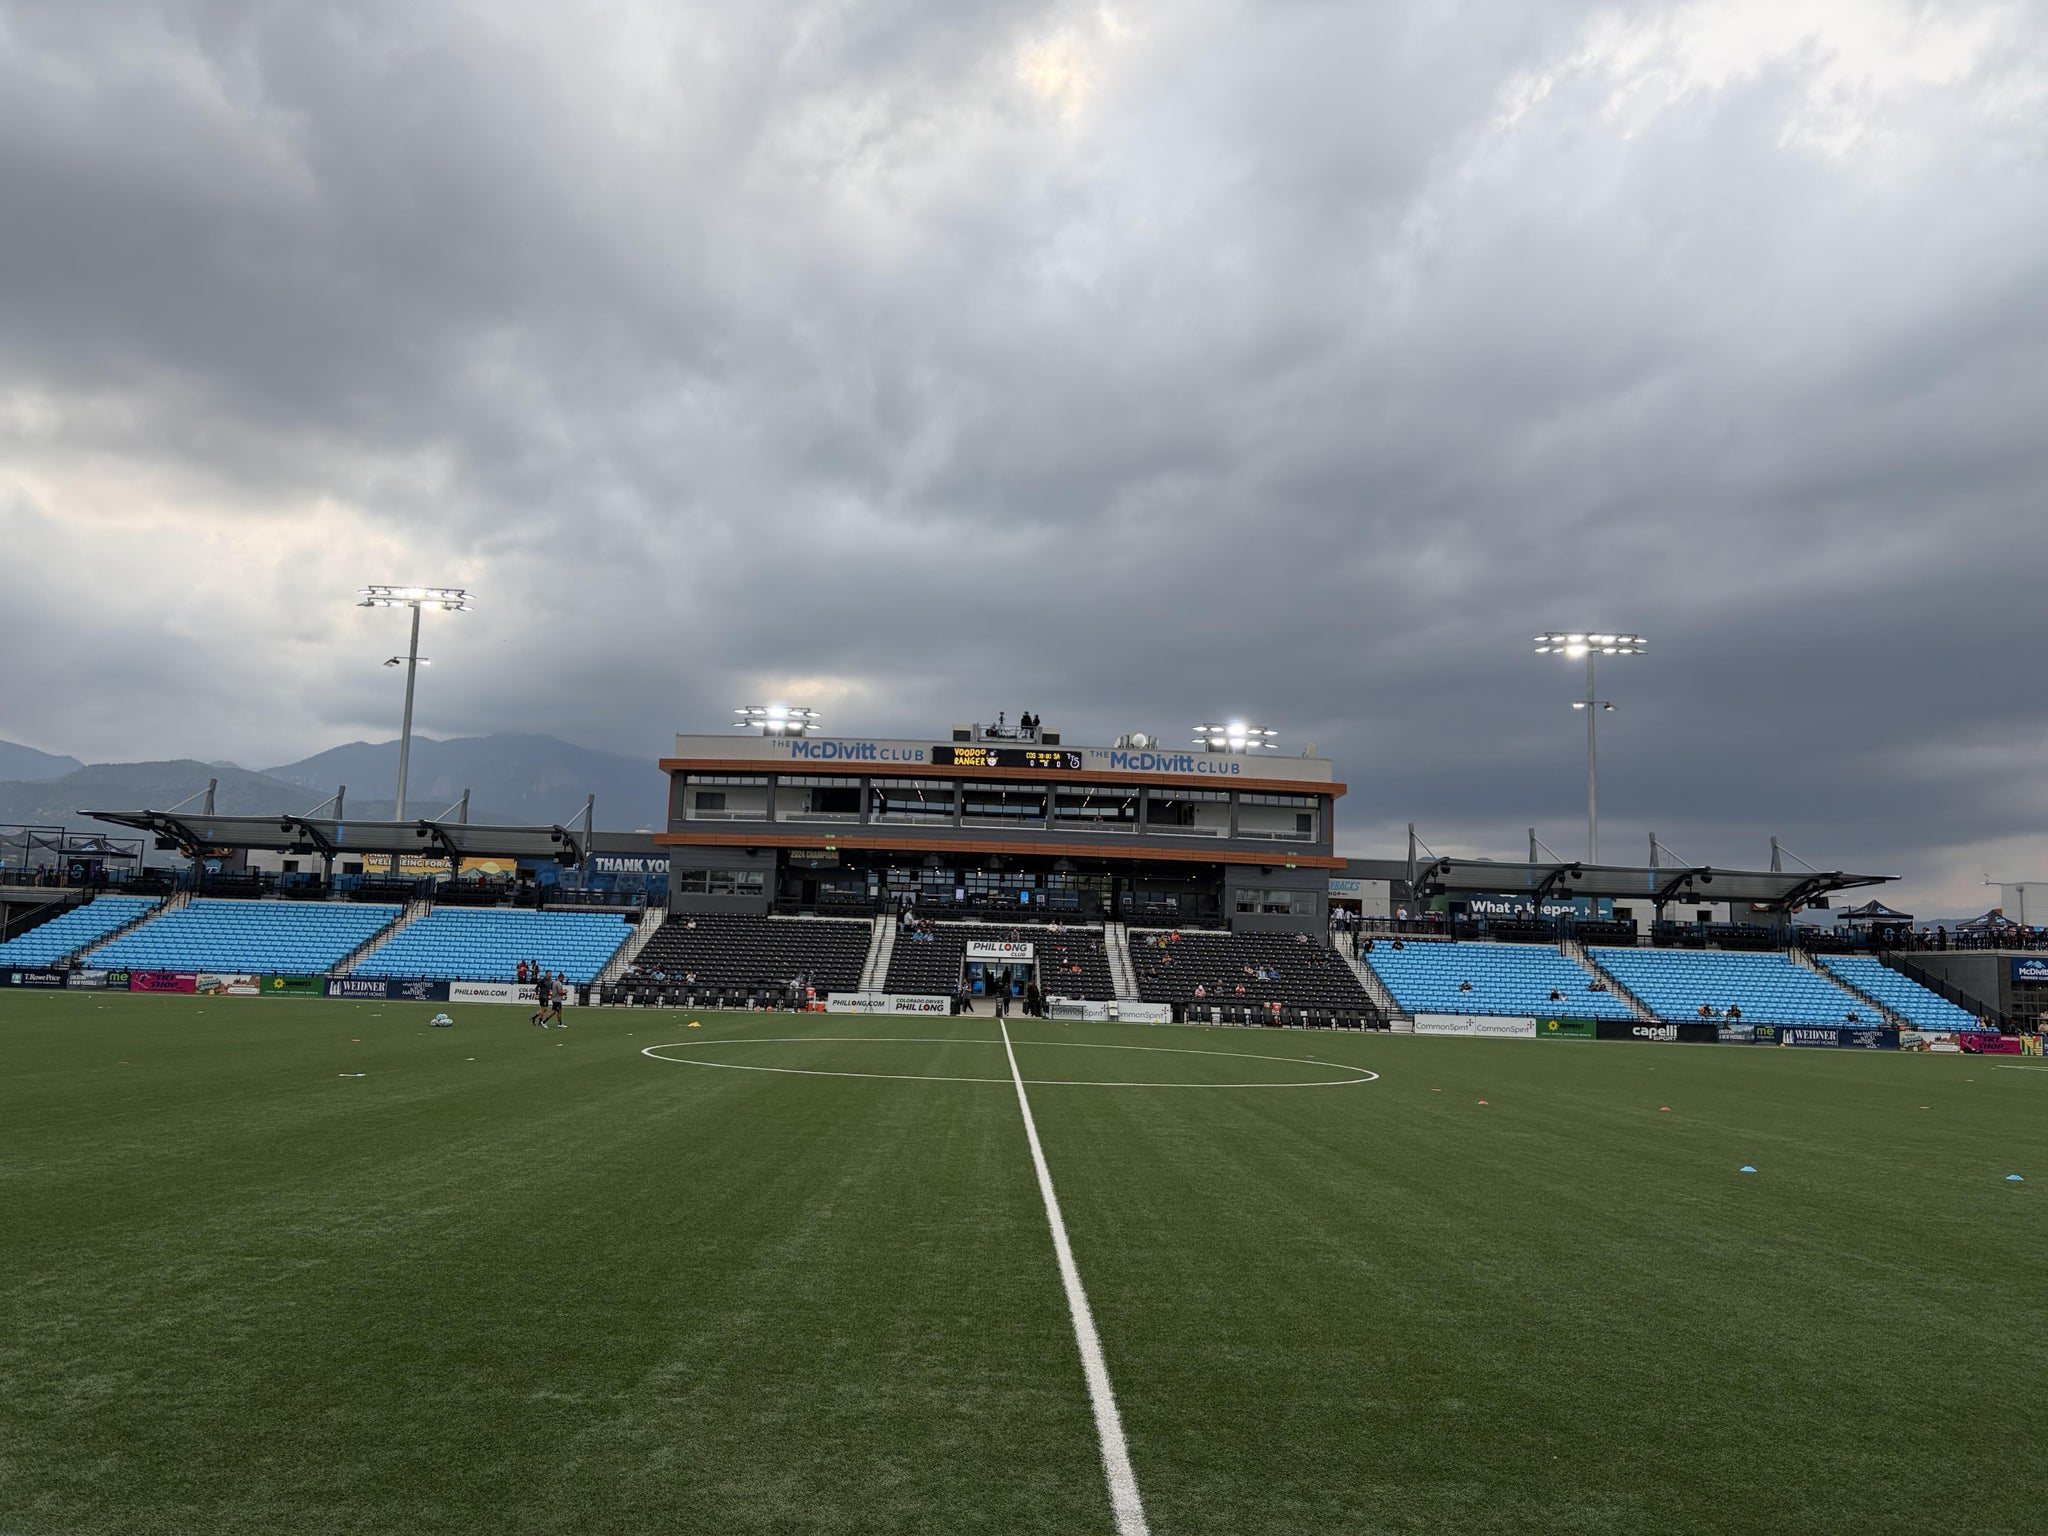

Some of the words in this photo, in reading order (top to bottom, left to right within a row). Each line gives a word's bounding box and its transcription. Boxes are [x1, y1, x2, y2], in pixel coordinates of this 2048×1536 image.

[792, 740, 877, 760] McDivitt
[880, 748, 924, 761] CLUB
[954, 748, 986, 756] VOODOO
[954, 757, 986, 766] RANGER
[1090, 750, 1109, 758] THE
[1110, 752, 1194, 772] McDivitt
[1197, 761, 1240, 774] CLUB
[595, 858, 643, 872] THANK
[1471, 900, 1510, 913] What
[1514, 903, 1523, 913] a
[1527, 902, 1579, 917] keper.
[973, 942, 997, 951] PHIL
[998, 943, 1028, 952] LONG
[110, 973, 128, 981] me
[343, 980, 385, 991] WEIDNER
[454, 989, 508, 997] PHILLONG.COM
[1118, 1010, 1163, 1019] ommonSpirit
[1416, 1022, 1469, 1031] CommonSpirit
[1477, 1024, 1529, 1034] CommonSpirit
[1632, 1025, 1678, 1039] capelli
[1757, 1028, 1774, 1036] me
[1795, 1029, 1836, 1040] WEIDNER
